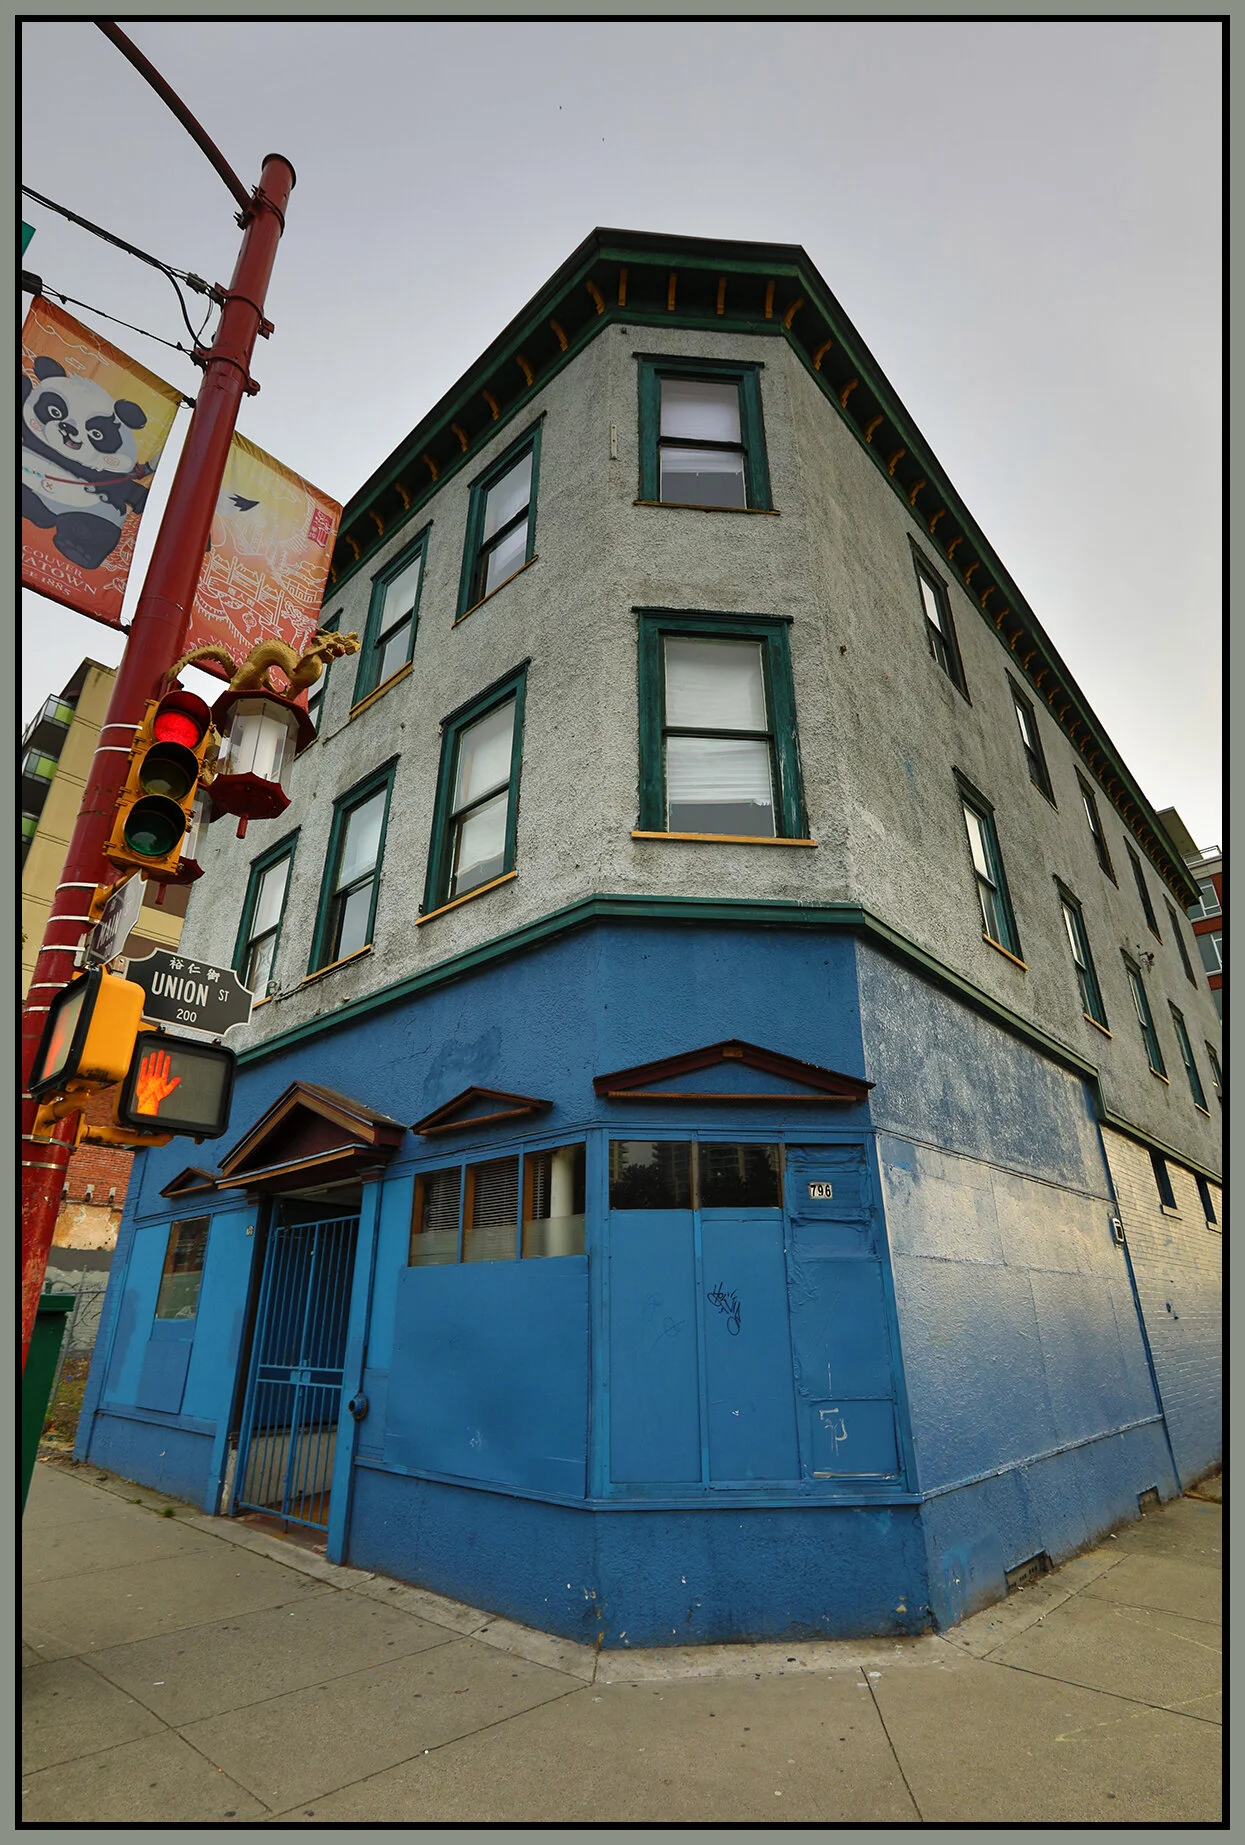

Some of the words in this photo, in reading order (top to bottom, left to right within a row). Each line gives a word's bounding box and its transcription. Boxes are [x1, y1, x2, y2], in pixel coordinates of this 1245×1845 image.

[41, 577, 71, 596] 1885
[151, 971, 209, 1007] UNION
[218, 989, 230, 1002] ST
[176, 1008, 197, 1023] 200
[810, 1184, 831, 1198] 796
